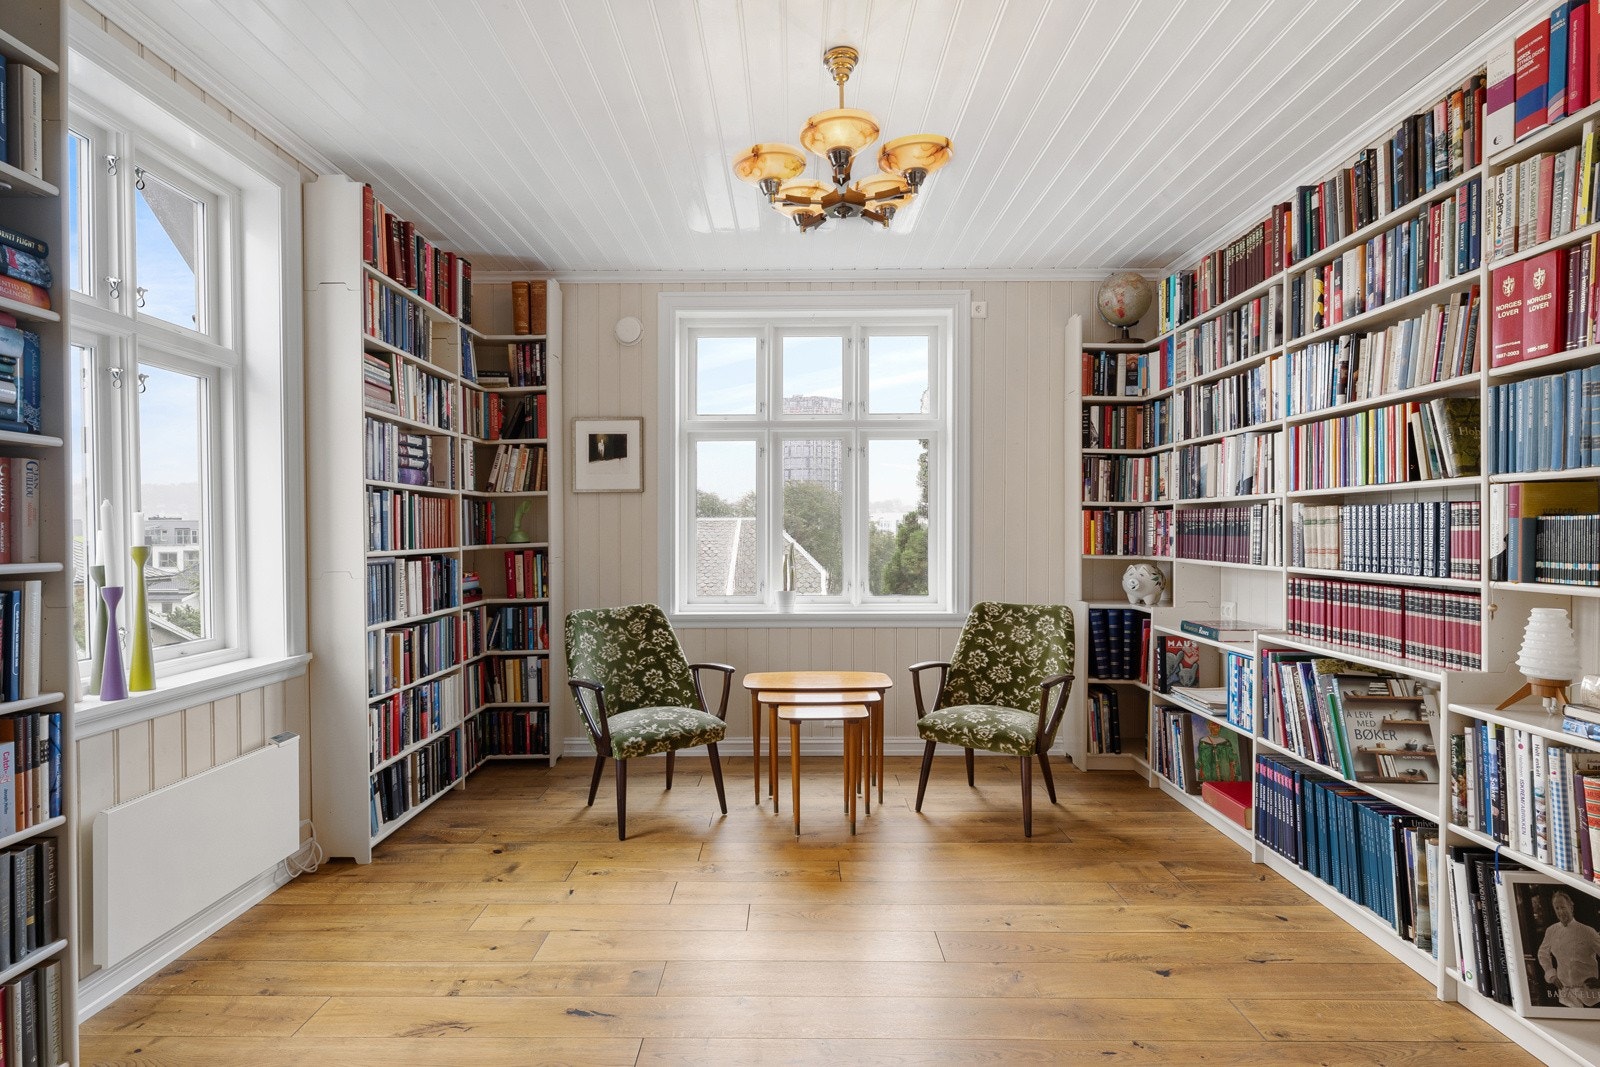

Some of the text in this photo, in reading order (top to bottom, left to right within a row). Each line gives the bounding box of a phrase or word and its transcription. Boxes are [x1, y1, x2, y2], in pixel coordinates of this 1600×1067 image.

[16, 236, 35, 249] FLIGHT
[1526, 292, 1552, 306] NORGES
[1496, 299, 1522, 312] NORGES
[1528, 301, 1549, 313] LOVER
[1497, 308, 1519, 319] LOVER
[1167, 639, 1198, 648] MAUS
[1354, 711, 1374, 719] LEVE
[1354, 729, 1398, 741] BØKER
